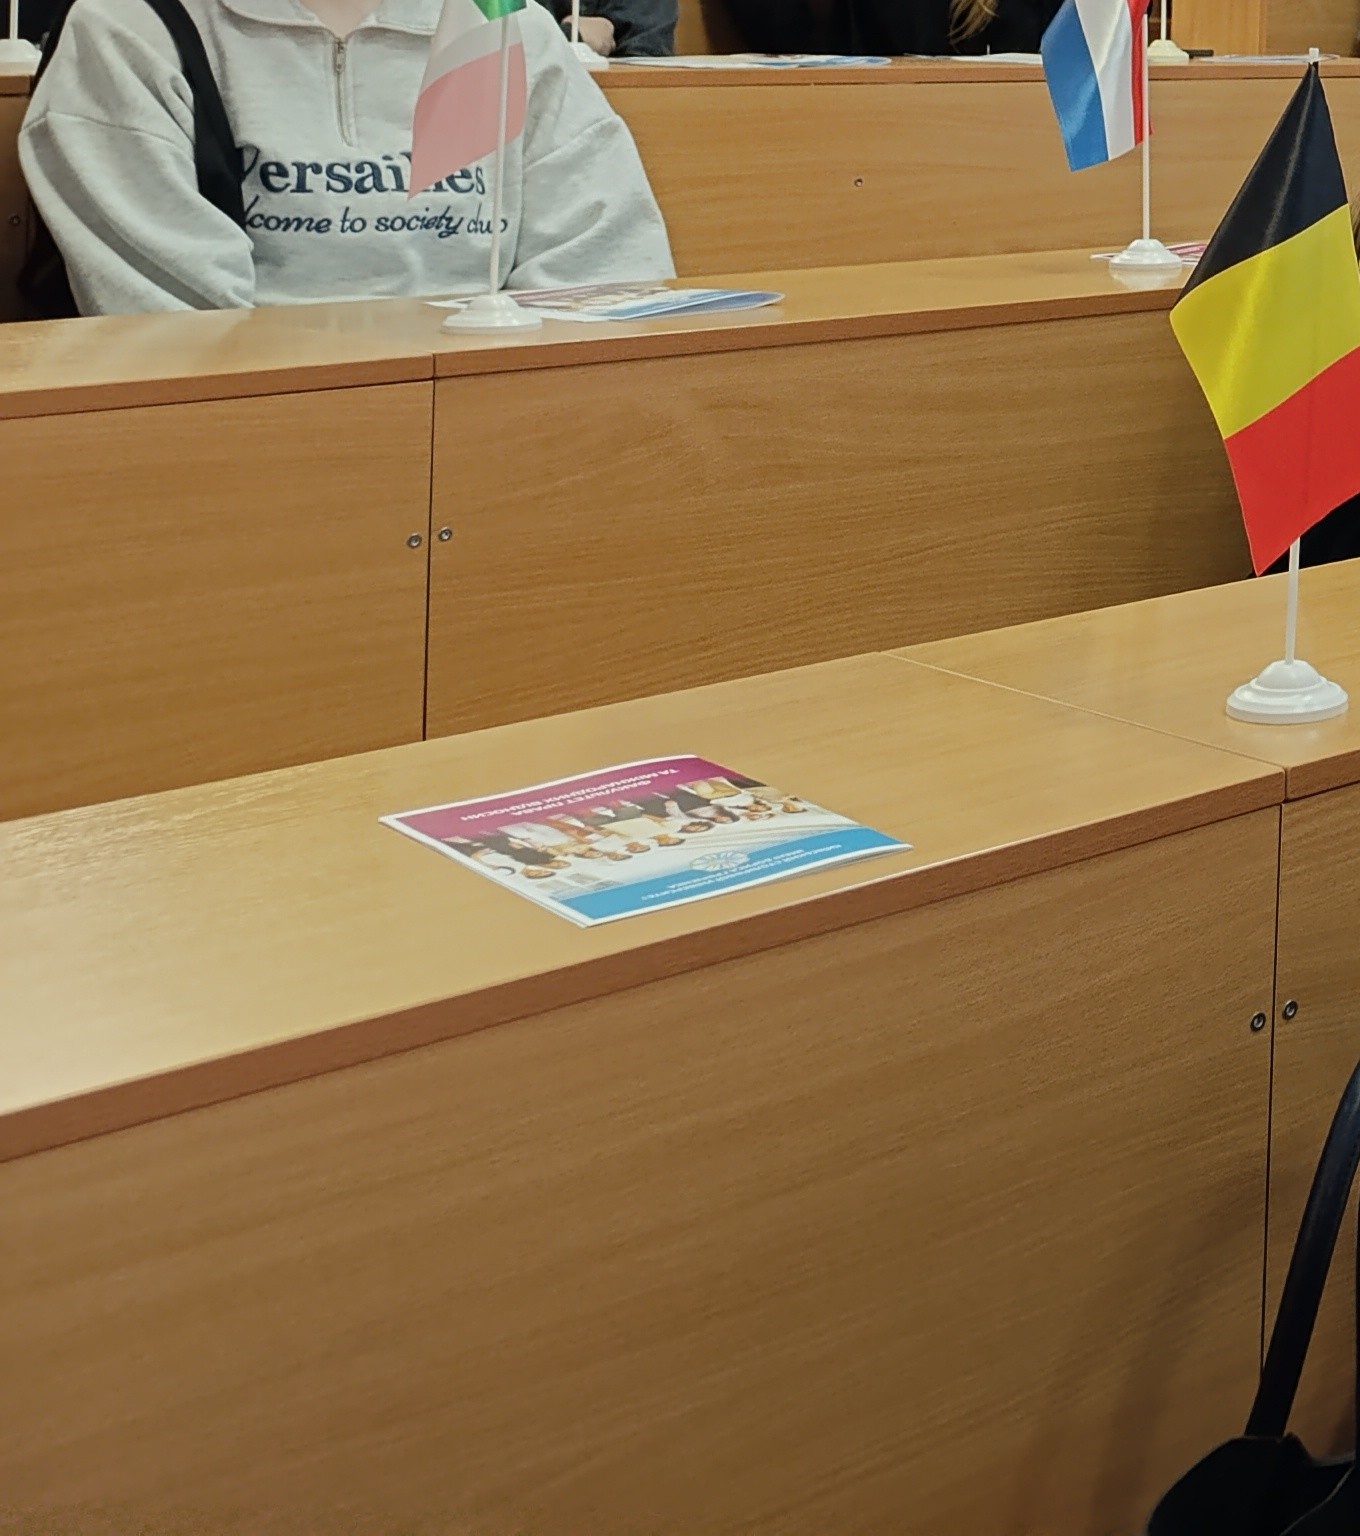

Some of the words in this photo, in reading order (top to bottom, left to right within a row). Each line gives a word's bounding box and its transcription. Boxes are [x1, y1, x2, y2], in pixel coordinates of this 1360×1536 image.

[339, 206, 367, 233] to
[374, 205, 465, 238] society
[510, 799, 566, 817] ПРАВА
